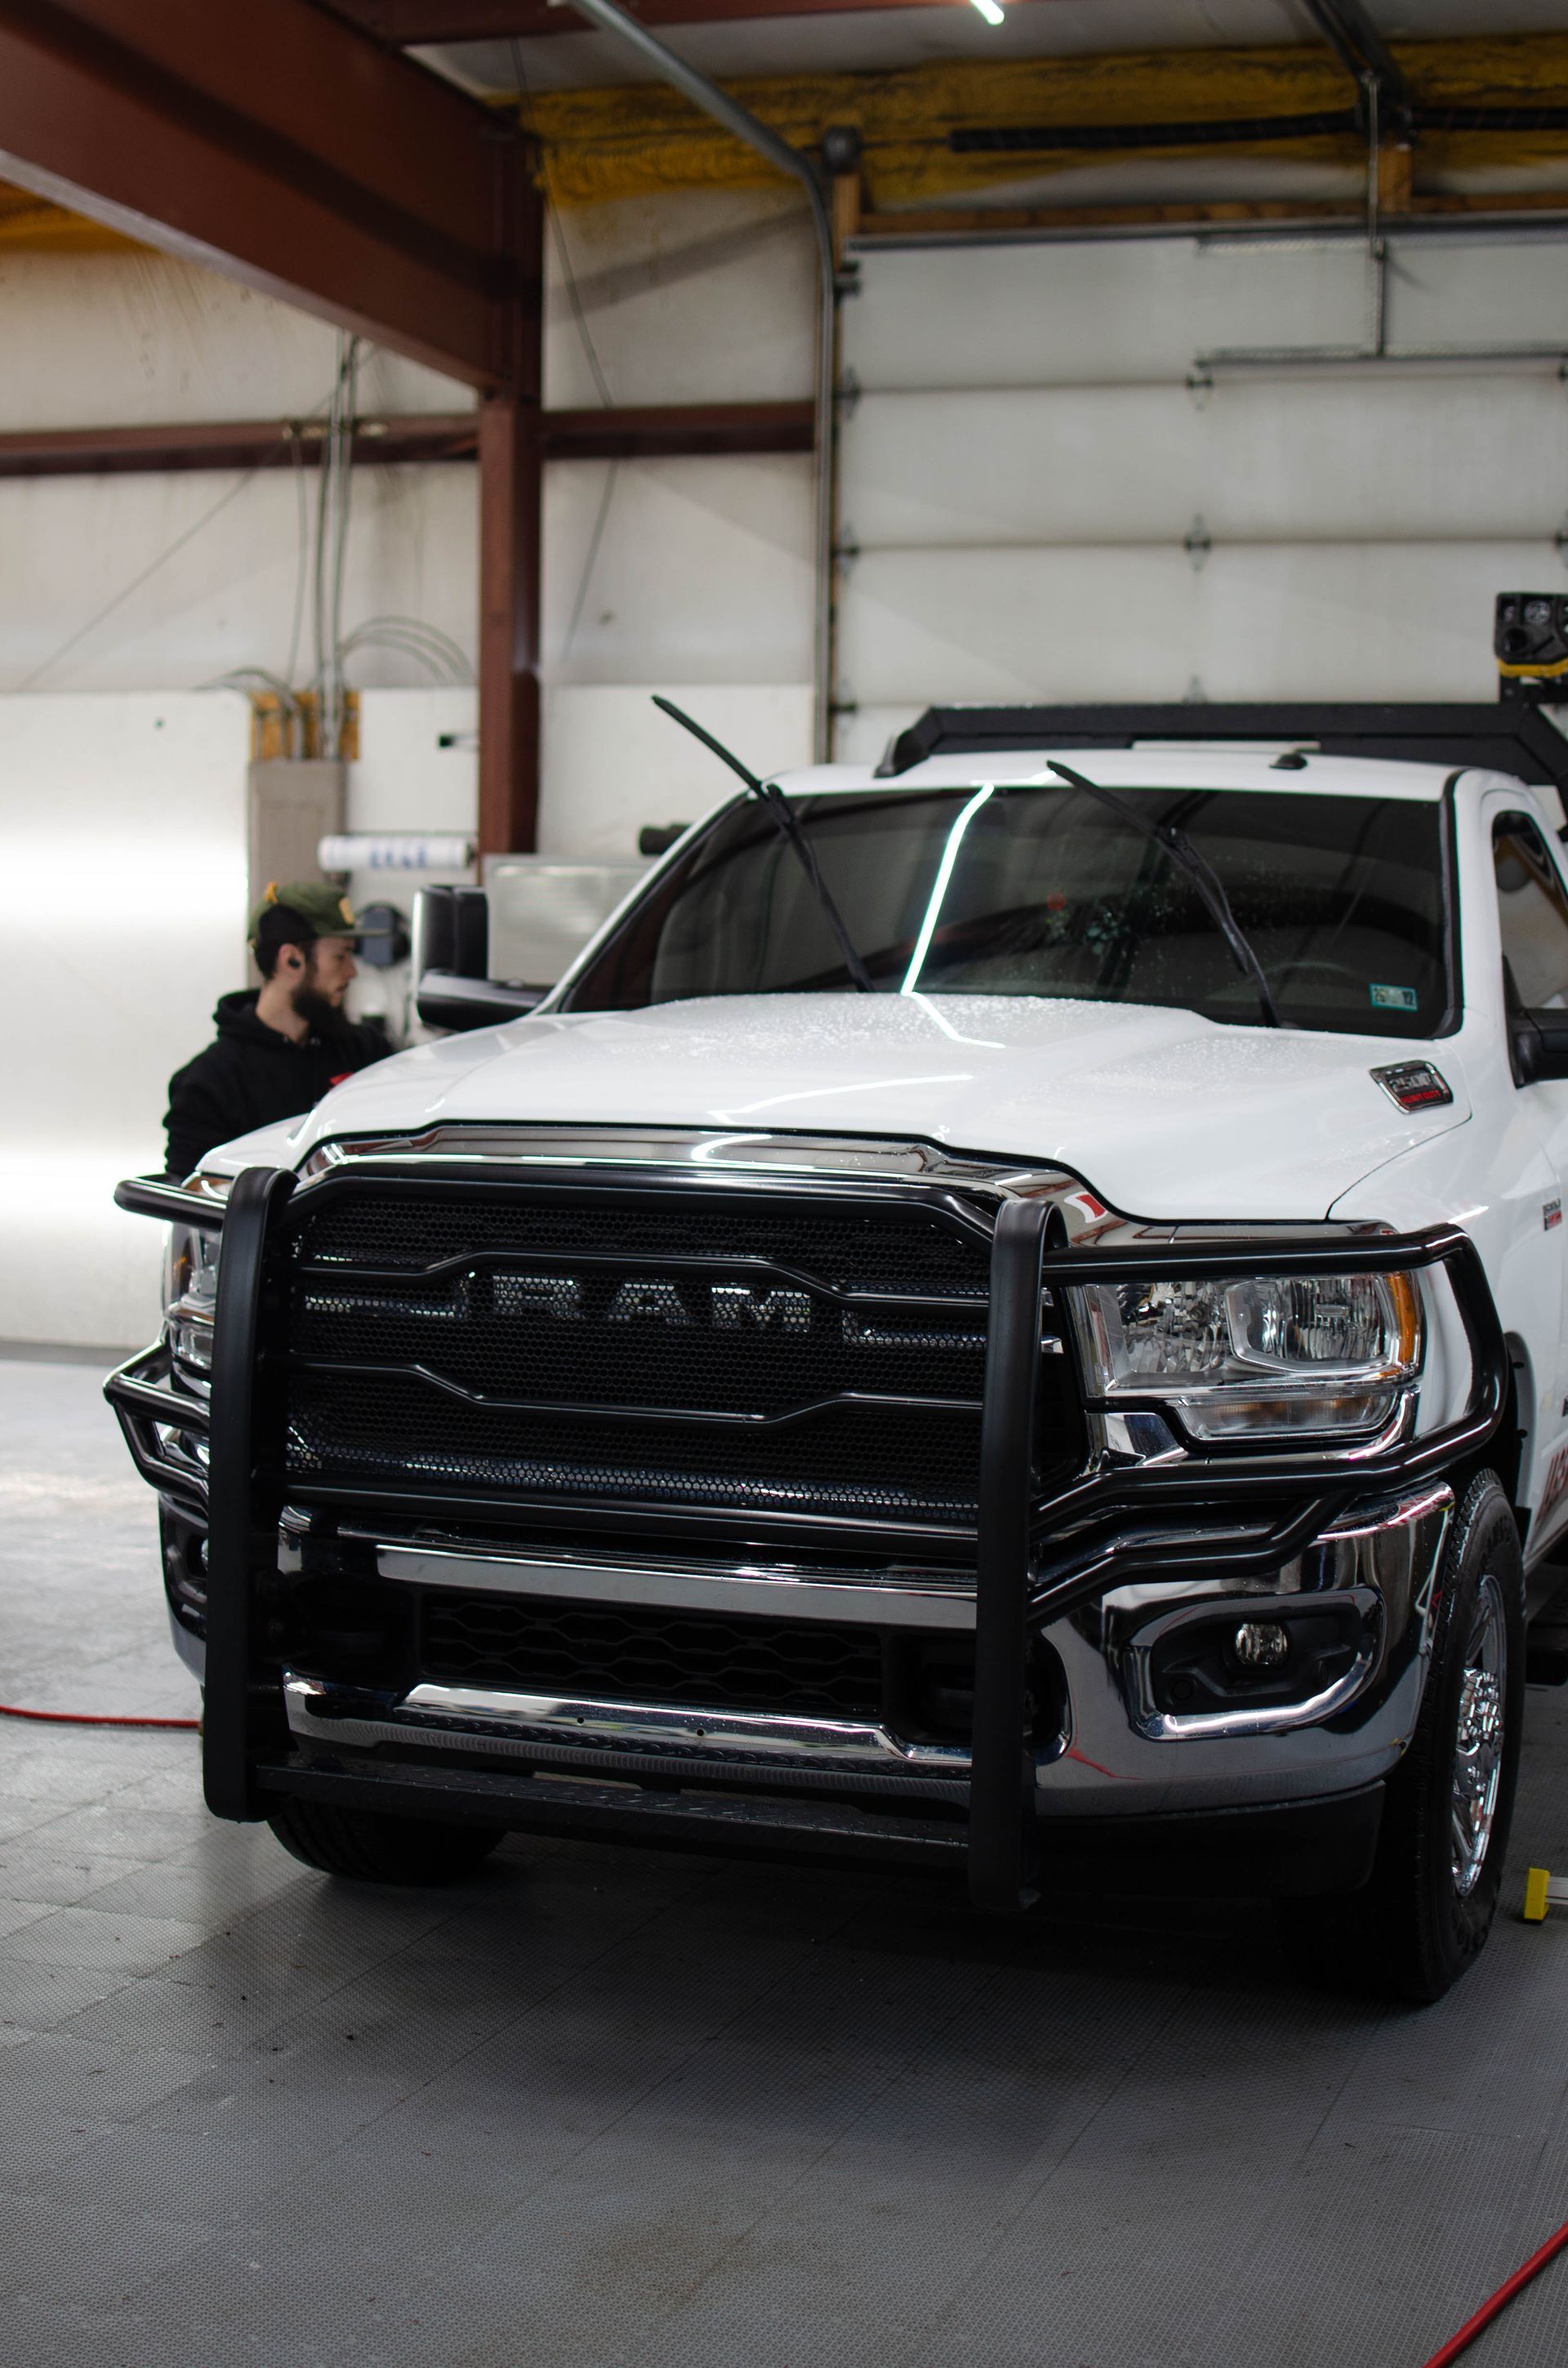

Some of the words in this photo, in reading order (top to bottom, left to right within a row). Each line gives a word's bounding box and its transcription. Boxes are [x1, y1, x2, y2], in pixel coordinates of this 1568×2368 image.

[1388, 1072, 1432, 1092] 2500
[1423, 1090, 1442, 1099] DUTY
[492, 1271, 813, 1332] RAM
